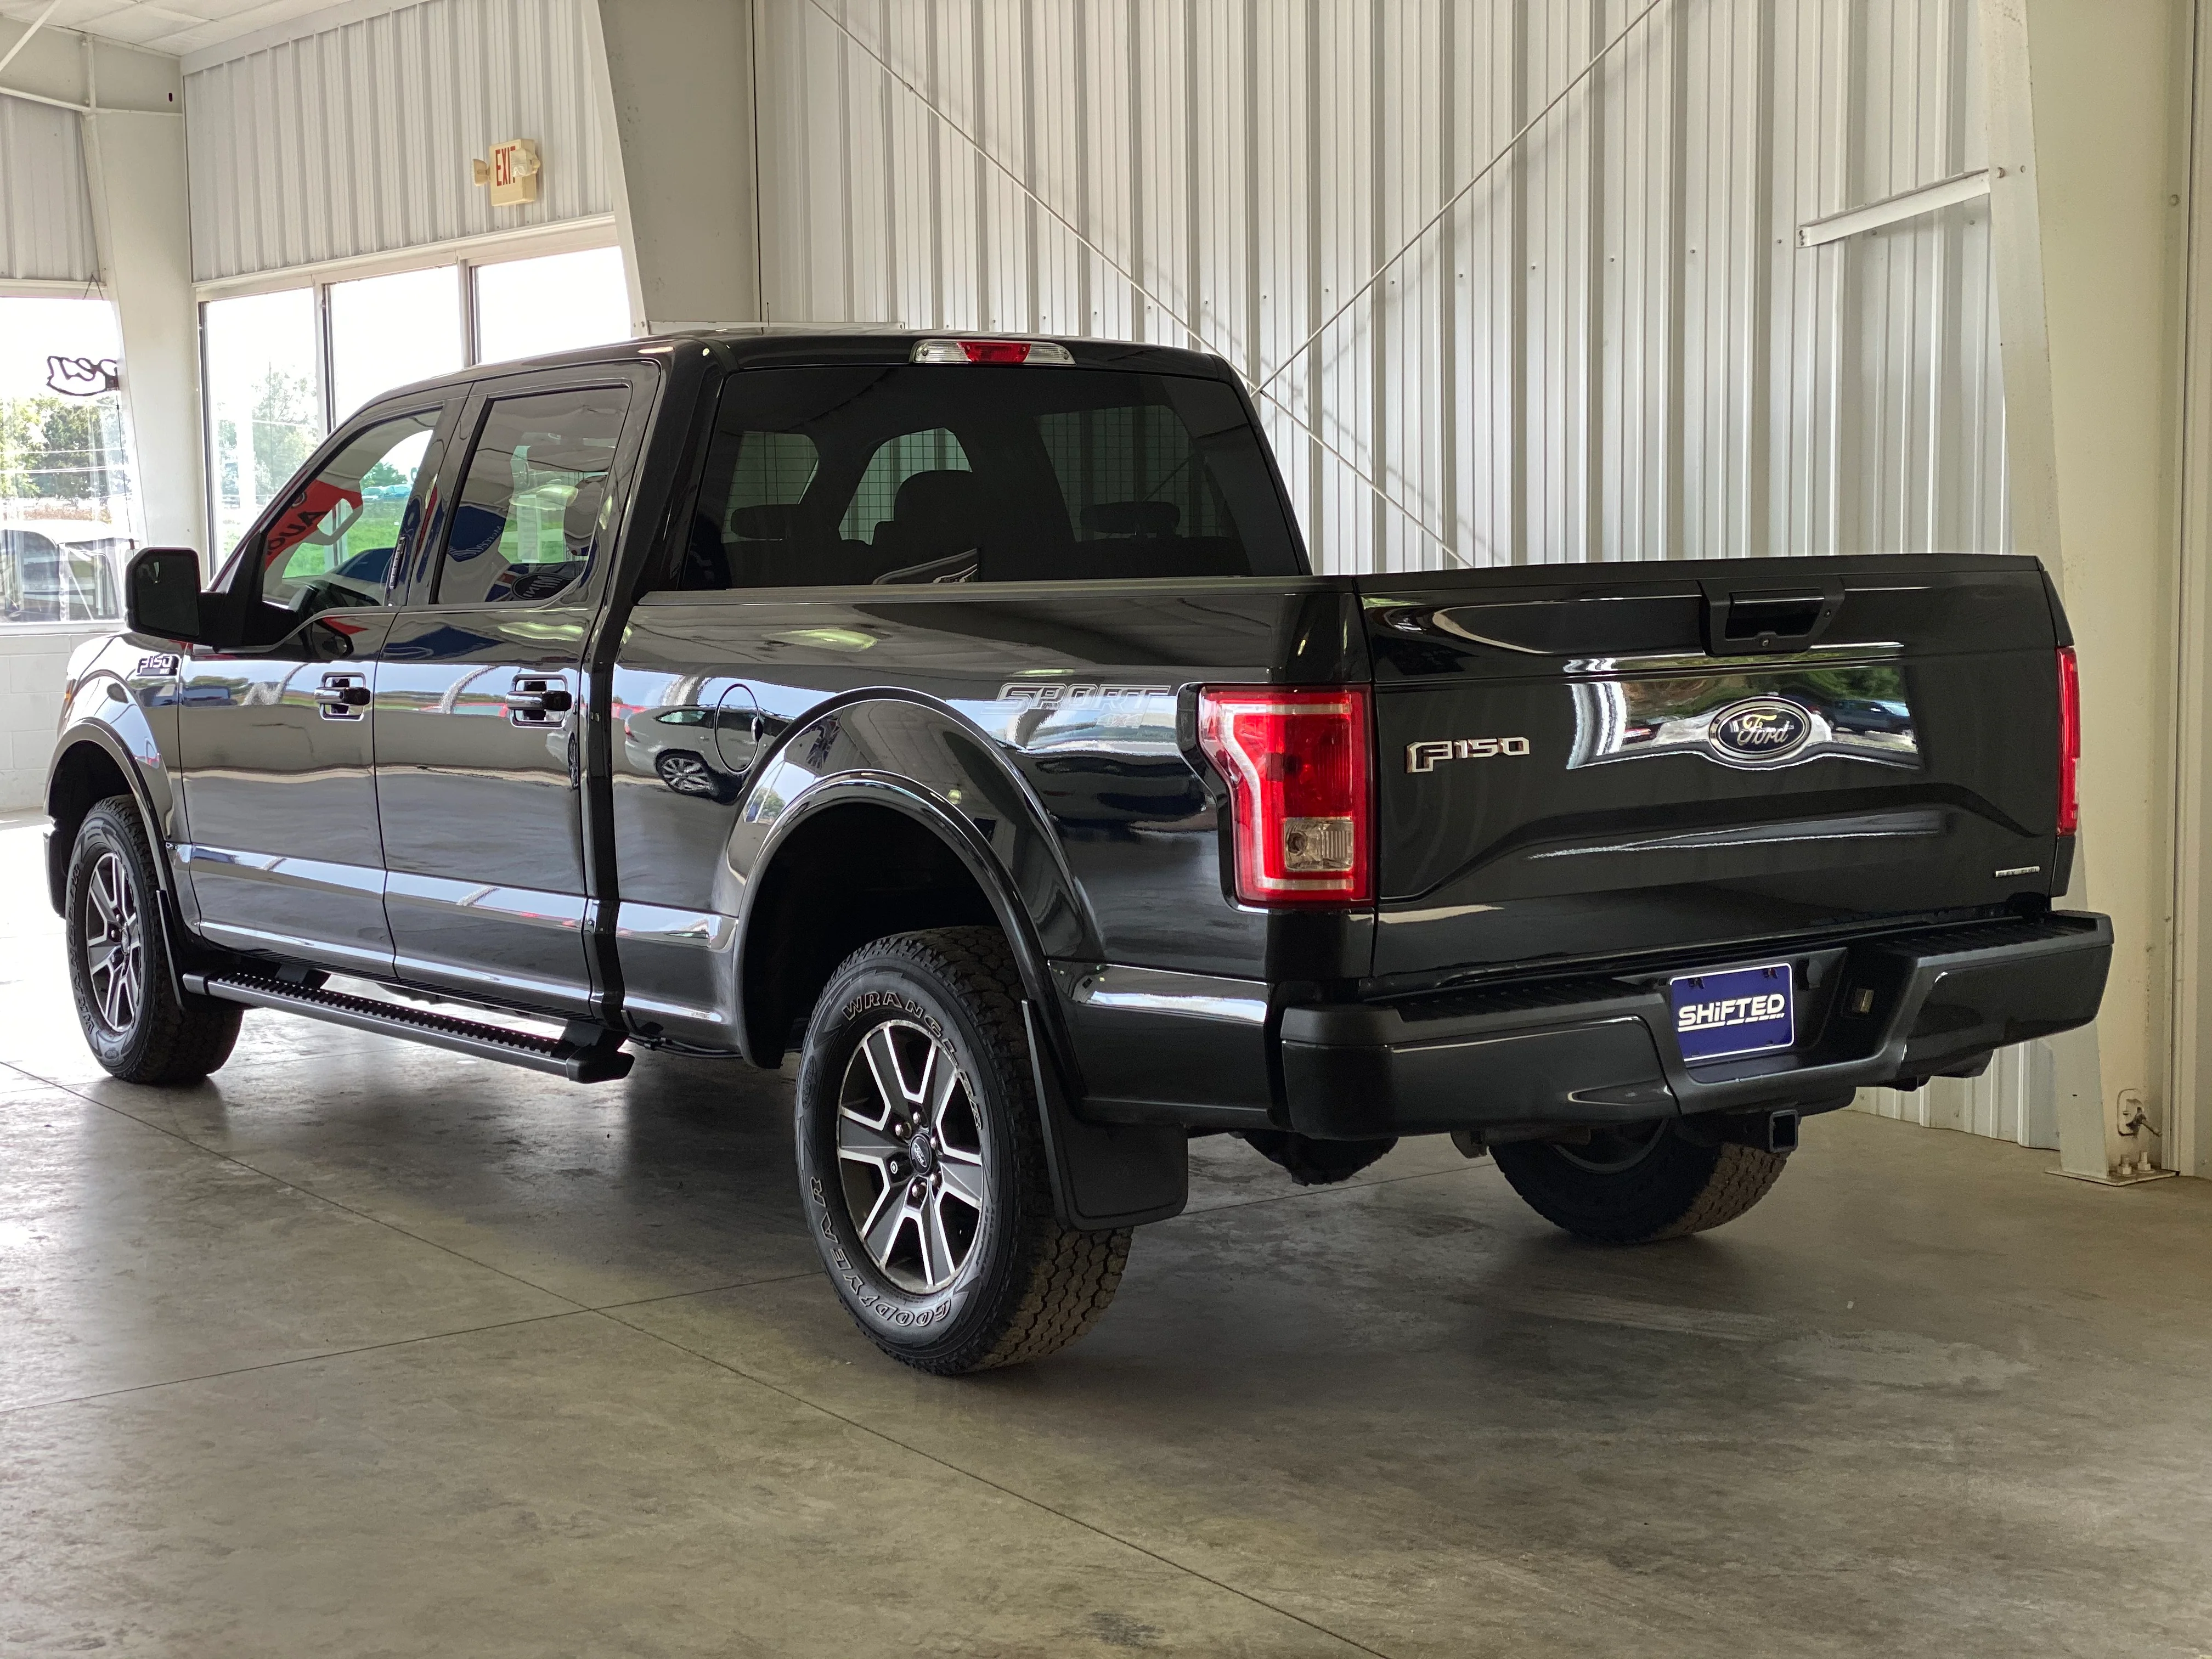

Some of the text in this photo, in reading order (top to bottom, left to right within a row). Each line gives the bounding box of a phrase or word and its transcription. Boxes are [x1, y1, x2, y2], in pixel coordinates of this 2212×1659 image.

[985, 682, 1171, 715] SPORT
[1737, 714, 1790, 746] Ford
[1405, 736, 1530, 774] F150
[810, 1176, 952, 1327] GOODYEAR
